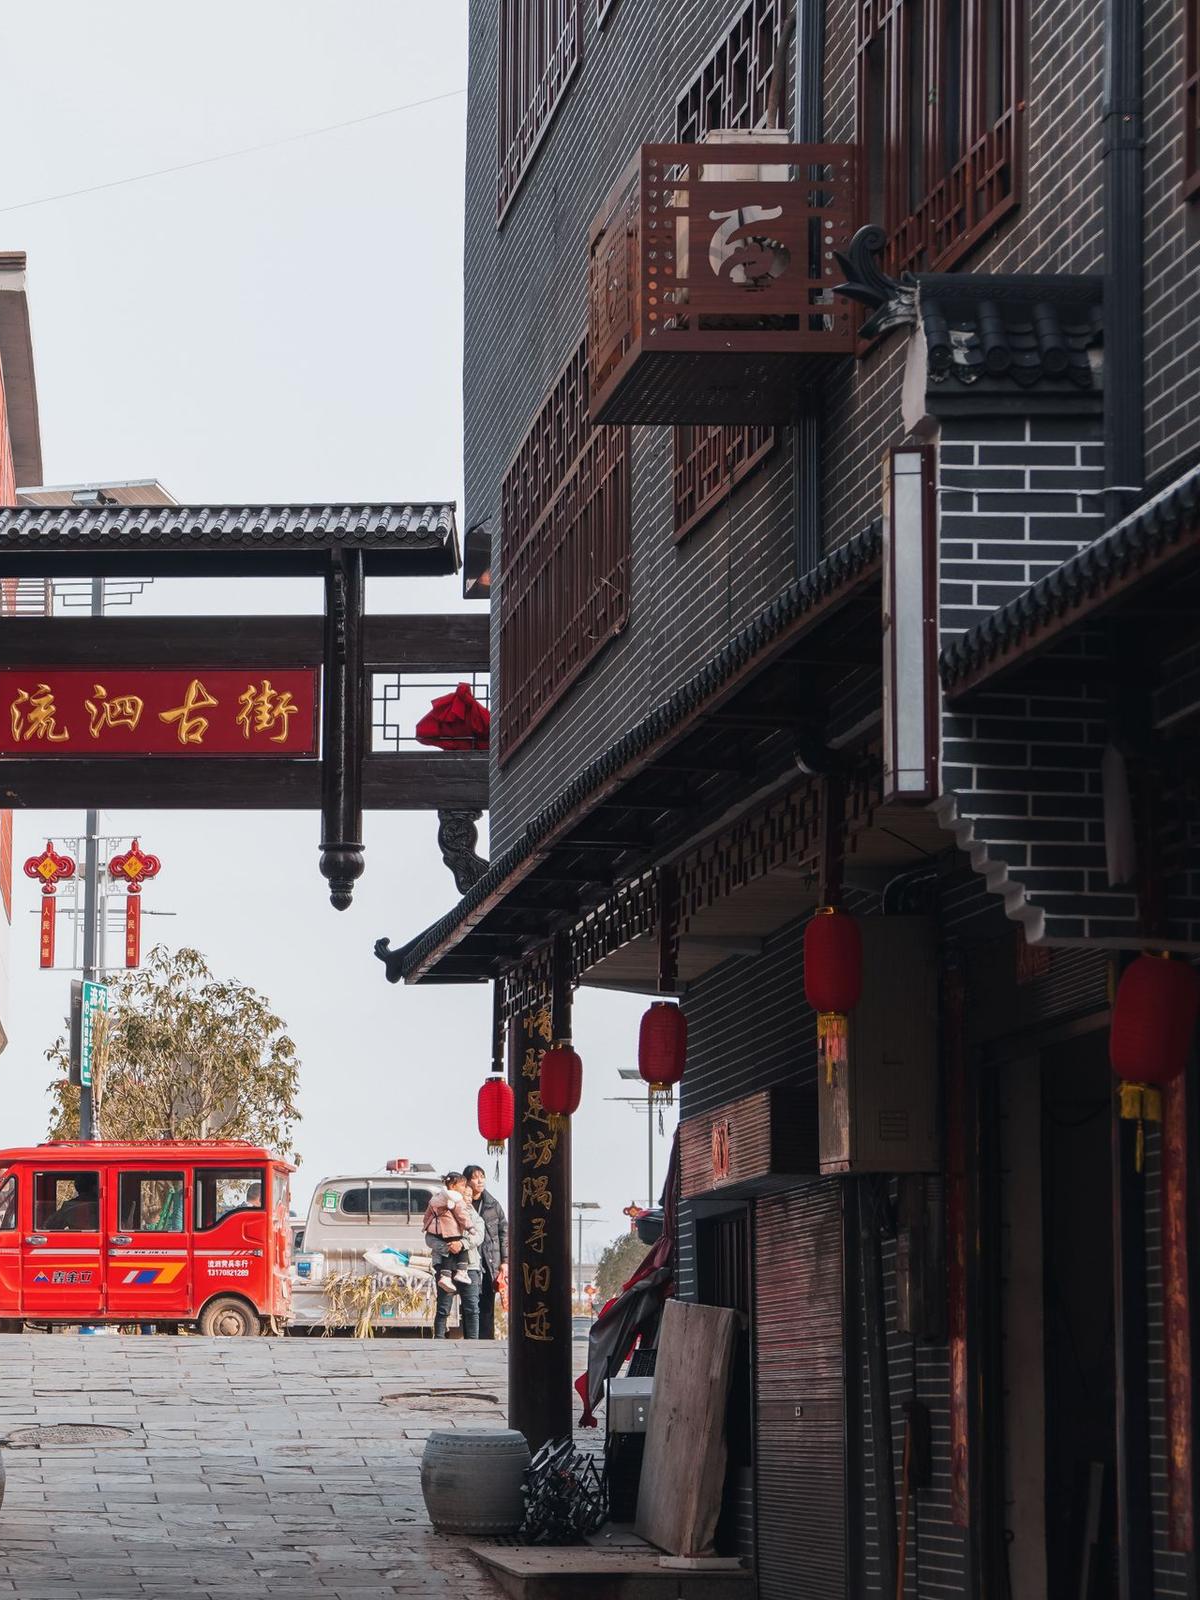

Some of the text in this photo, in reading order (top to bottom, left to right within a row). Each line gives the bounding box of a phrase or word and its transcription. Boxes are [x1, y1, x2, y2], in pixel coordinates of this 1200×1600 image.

[10, 678, 298, 744] 流泗古街
[521, 980, 554, 1342] 情驻足坊隅寻旧迹
